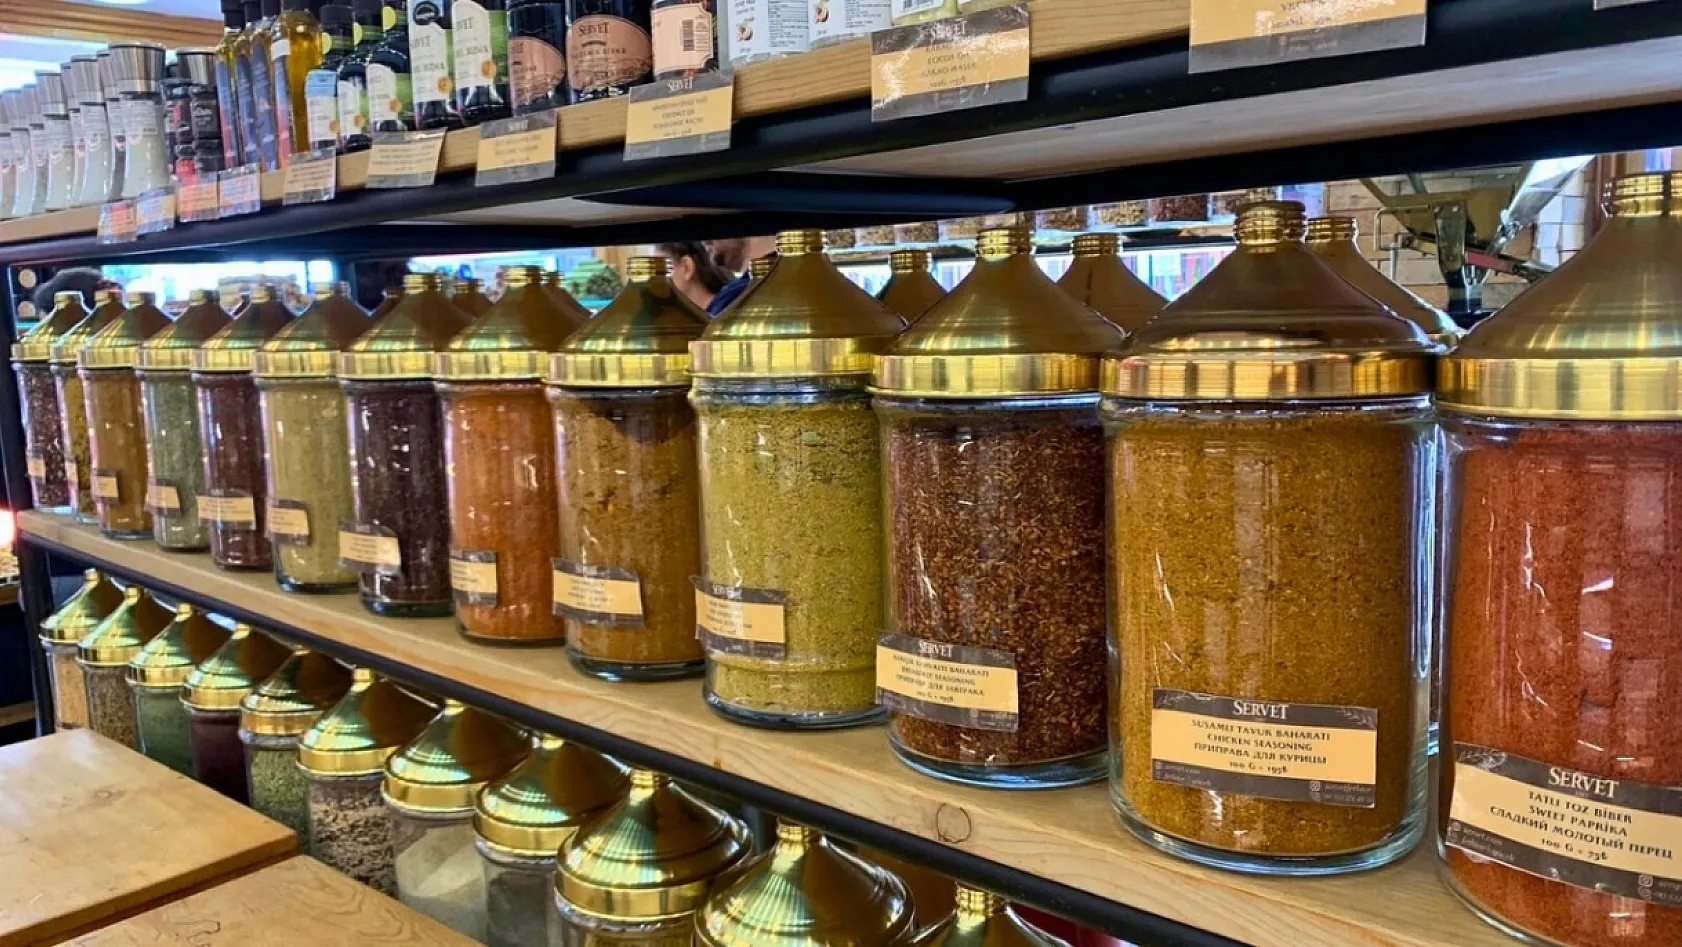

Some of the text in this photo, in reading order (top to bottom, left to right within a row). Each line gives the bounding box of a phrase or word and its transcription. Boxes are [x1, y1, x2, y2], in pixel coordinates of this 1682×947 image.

[918, 640, 954, 658] SERVET
[1232, 699, 1289, 720] SERVET
[1207, 733, 1313, 752] CHICKEN SEASONING
[1236, 725, 1272, 736] TAVUK
[1275, 729, 1331, 741] BAHARATI
[1194, 742, 1327, 765] ПРИПРАВА ДЛЯ КУРИЦЫ
[1547, 767, 1619, 799] SERVET
[1528, 790, 1561, 807] TATLI
[1565, 801, 1589, 814] TOZ
[1529, 805, 1566, 822] SWEET
[1489, 805, 1673, 860] СЛАДКИЙ МОЛОТЫЙ ПЕРЕЦ
[1541, 838, 1560, 849] 100
[1565, 843, 1574, 853] G
